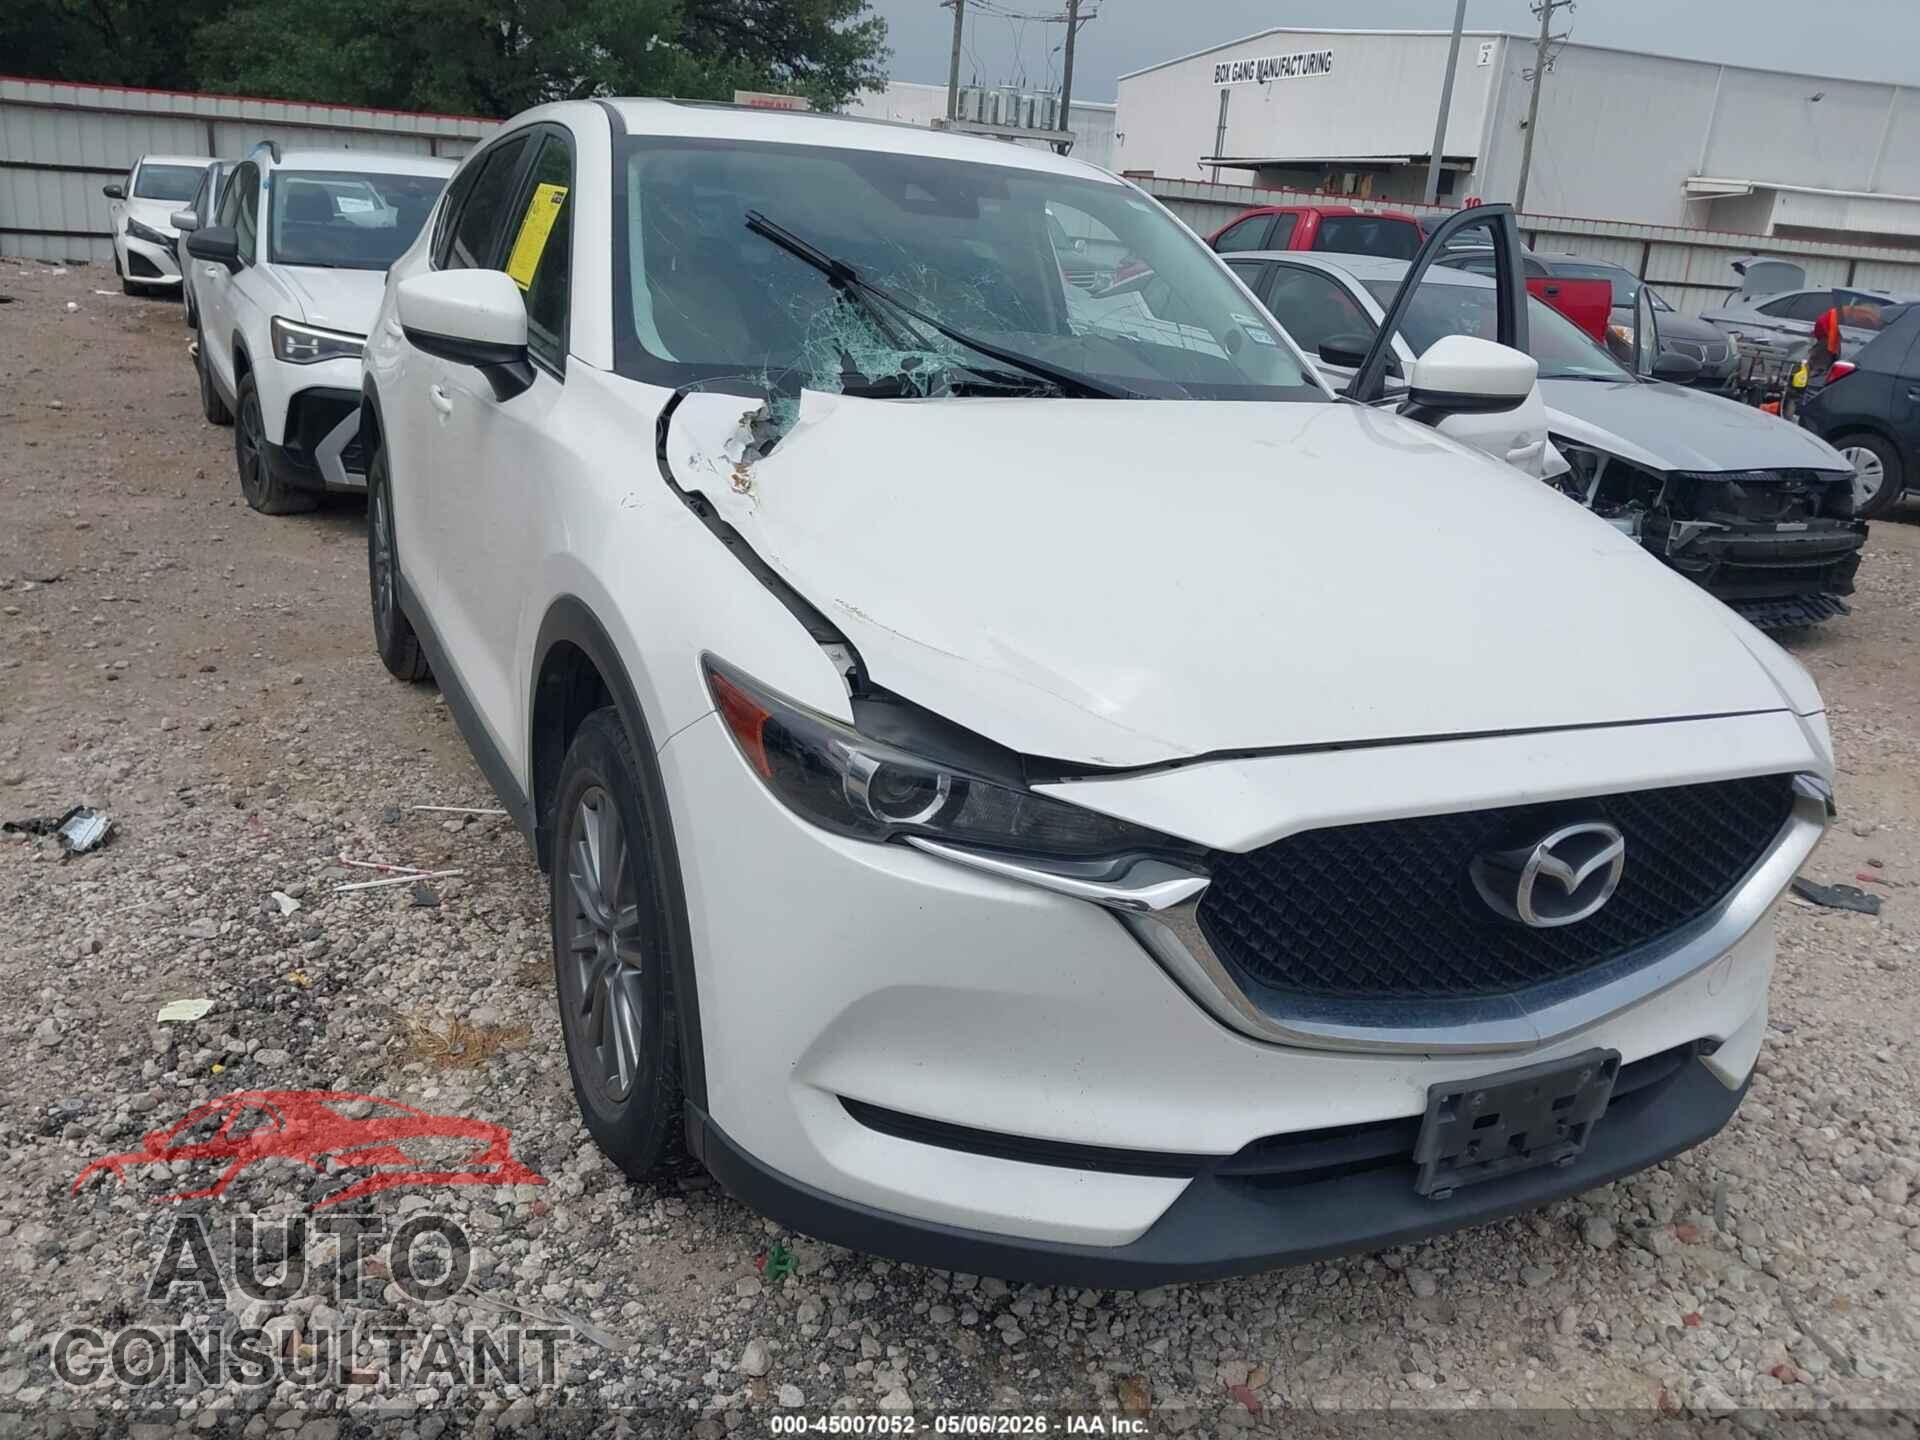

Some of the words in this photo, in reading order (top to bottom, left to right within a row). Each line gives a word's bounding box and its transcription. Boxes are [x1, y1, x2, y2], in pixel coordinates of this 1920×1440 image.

[1214, 63, 1231, 83] BOX
[1231, 61, 1255, 82] GANG
[1255, 51, 1332, 80] MANUFACTURING
